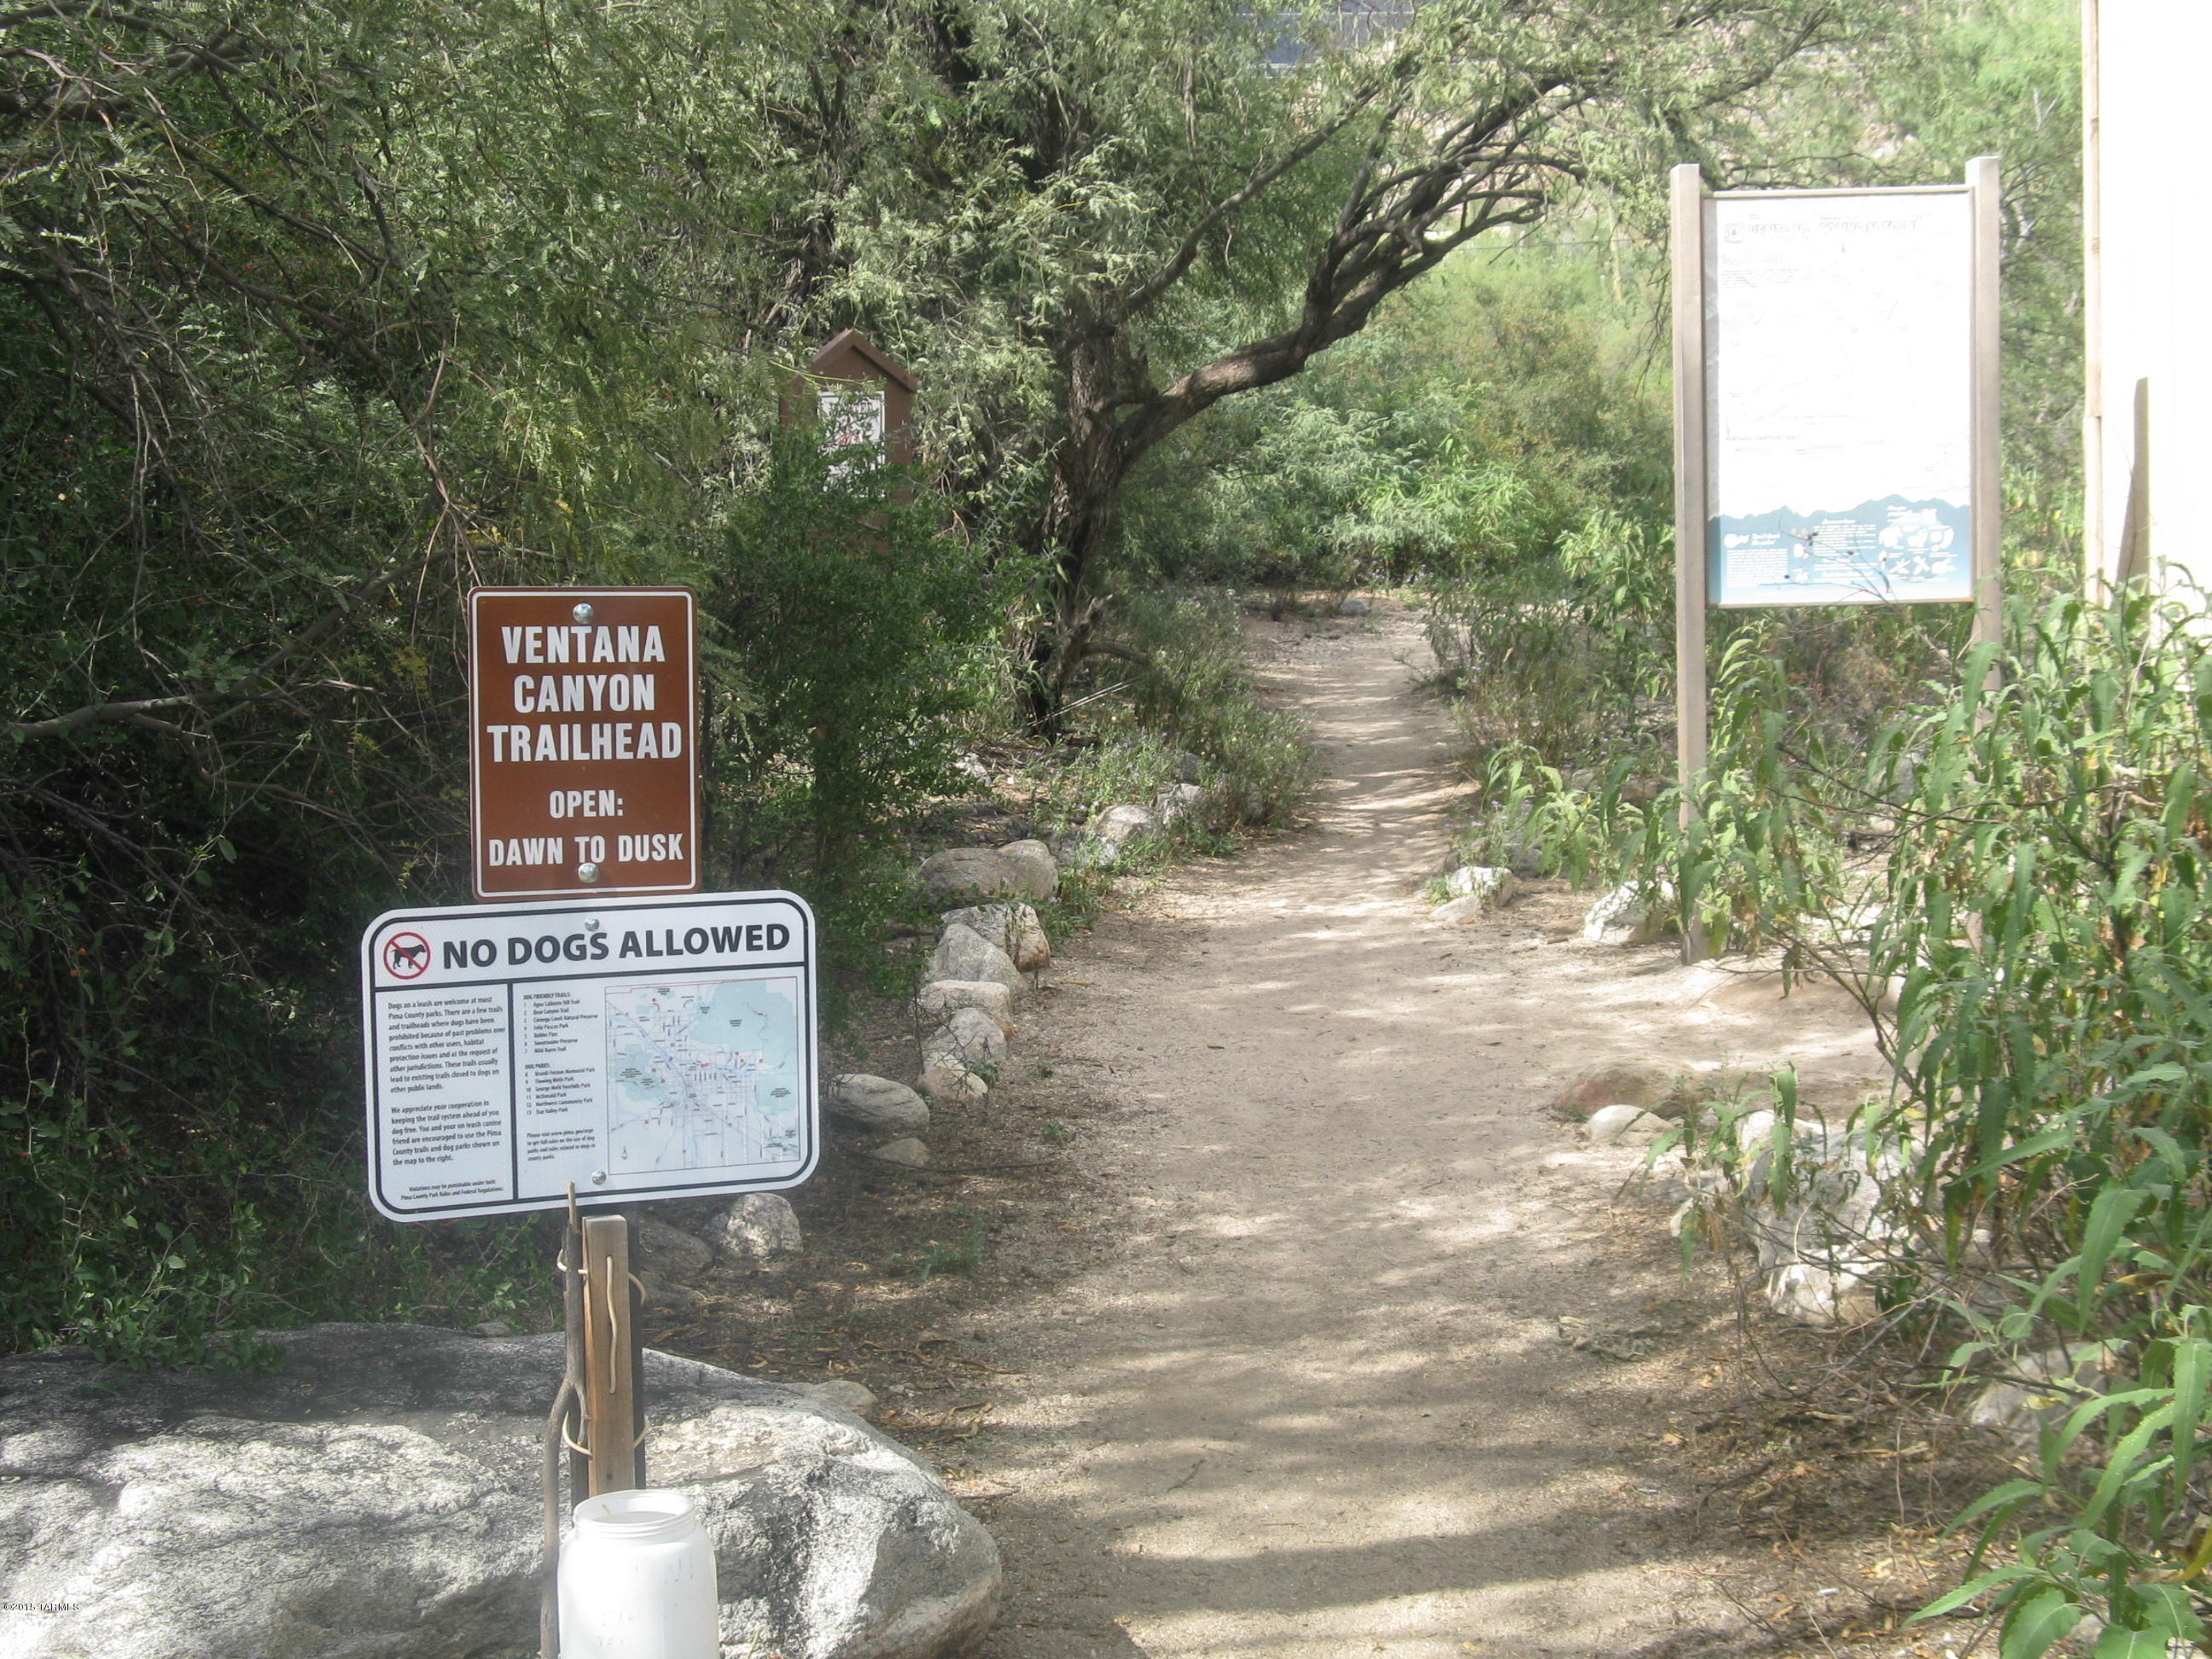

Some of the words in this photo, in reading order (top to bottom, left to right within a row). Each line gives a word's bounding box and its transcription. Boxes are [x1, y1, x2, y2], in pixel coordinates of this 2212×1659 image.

[502, 626, 666, 664] VENTANA
[514, 674, 655, 713] CANYON
[487, 722, 682, 763] TRAILHEAD
[550, 790, 624, 819] OPEN:
[489, 837, 563, 866] DAWN
[575, 835, 606, 864] TO
[619, 834, 684, 862] DUSK
[444, 940, 498, 969] NO
[508, 933, 609, 965] DOGS
[619, 923, 791, 958] ALLOWED
[389, 1033, 419, 1042] prohibited
[466, 1027, 492, 1036] problems
[389, 1054, 420, 1062] protection
[448, 1101, 482, 1109] cooperation
[422, 1133, 456, 1142] encouraged
[455, 1143, 470, 1151] parks
